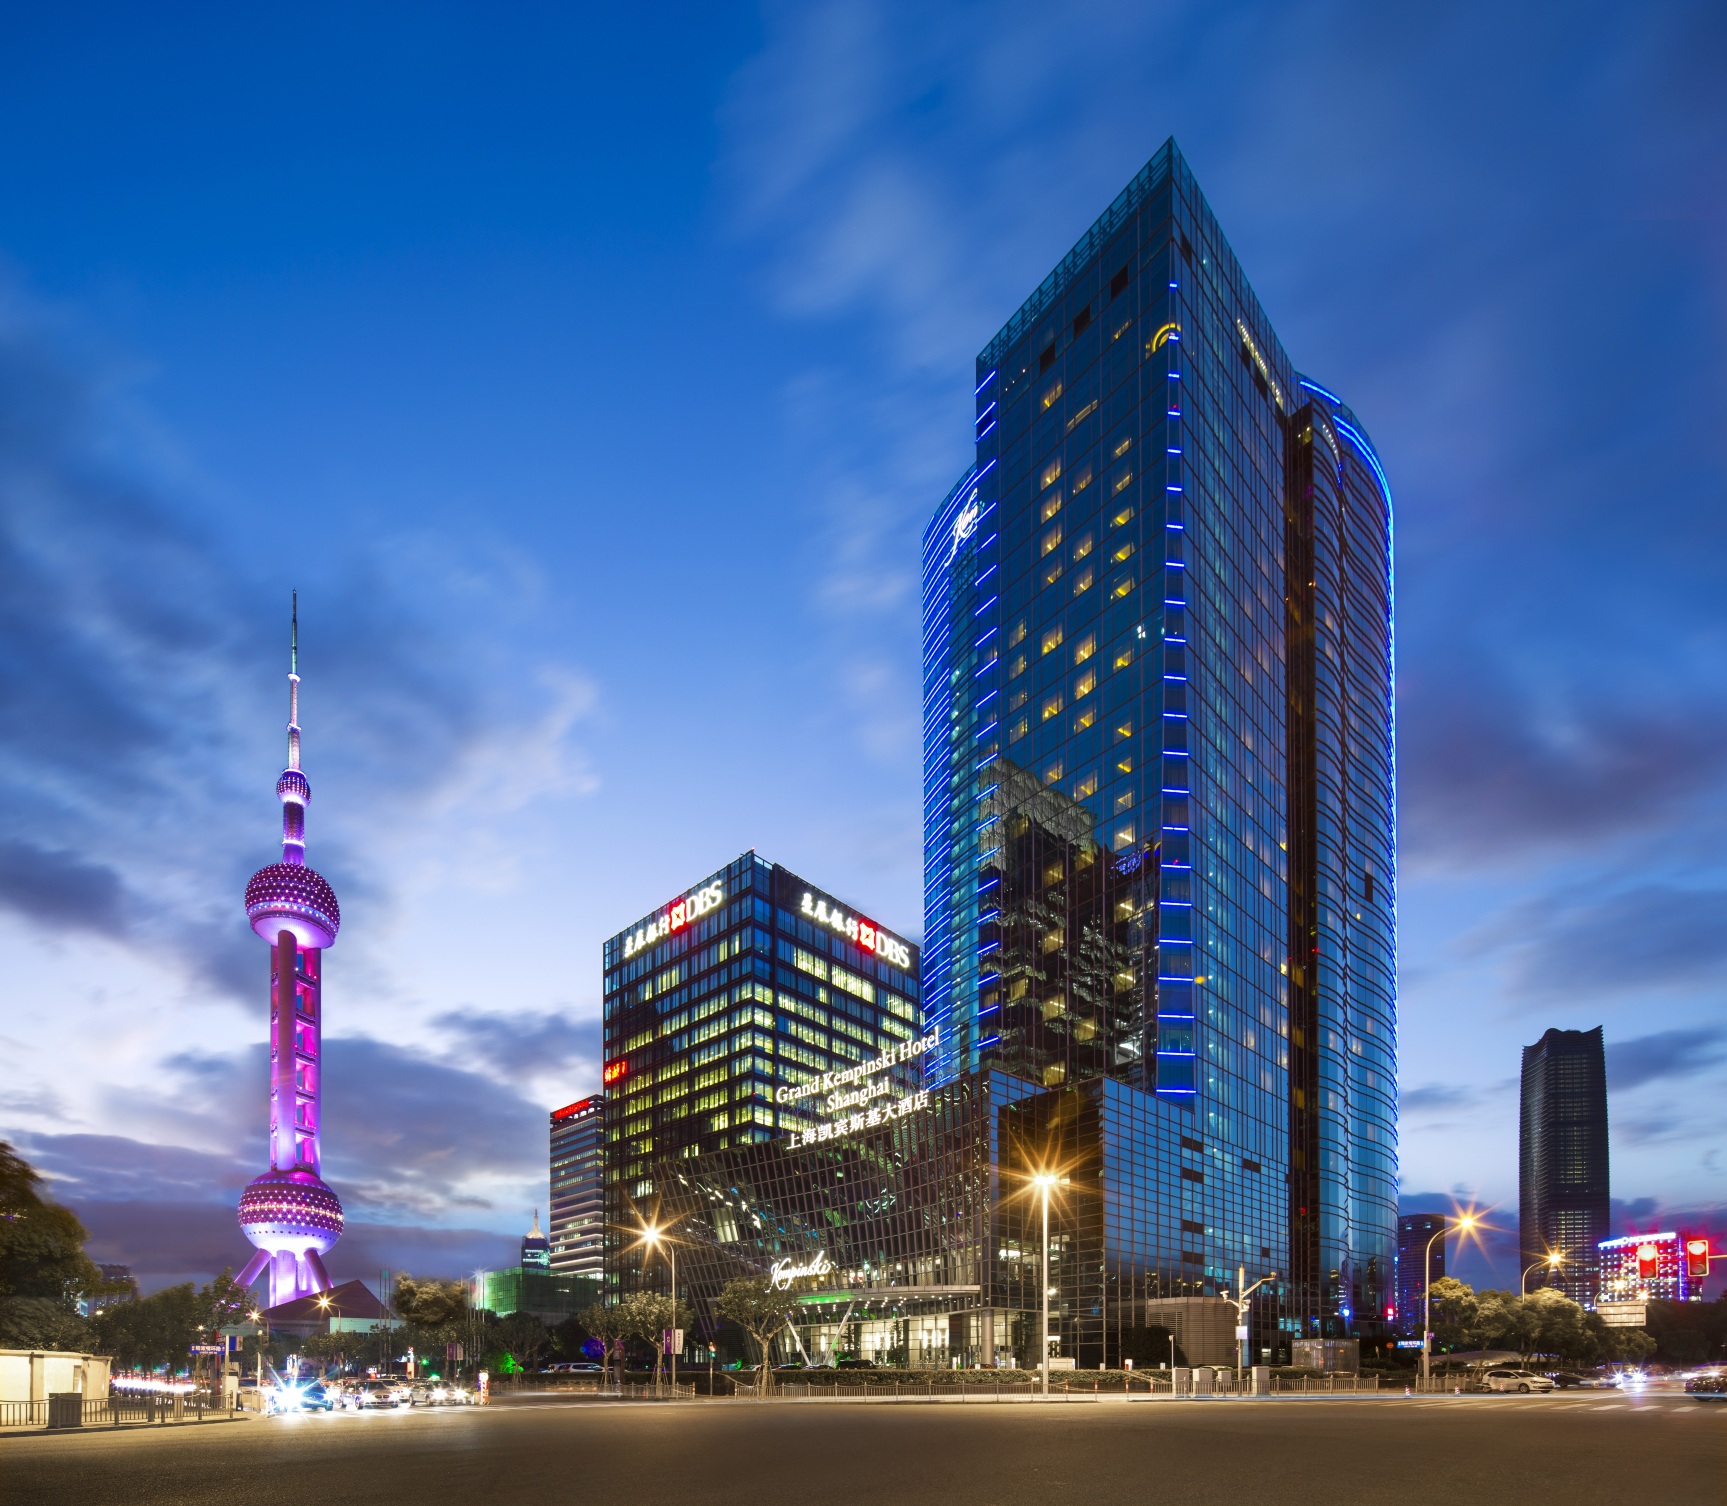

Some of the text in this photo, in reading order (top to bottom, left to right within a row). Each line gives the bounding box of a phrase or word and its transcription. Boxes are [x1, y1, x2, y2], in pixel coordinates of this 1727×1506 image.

[686, 880, 723, 922] DBS
[876, 931, 910, 968] DBS
[776, 1025, 940, 1104] Grand Kempinski Hotel
[826, 1076, 890, 1113] Shanghai
[786, 1089, 930, 1150] 上海凯宾斯基大酒店
